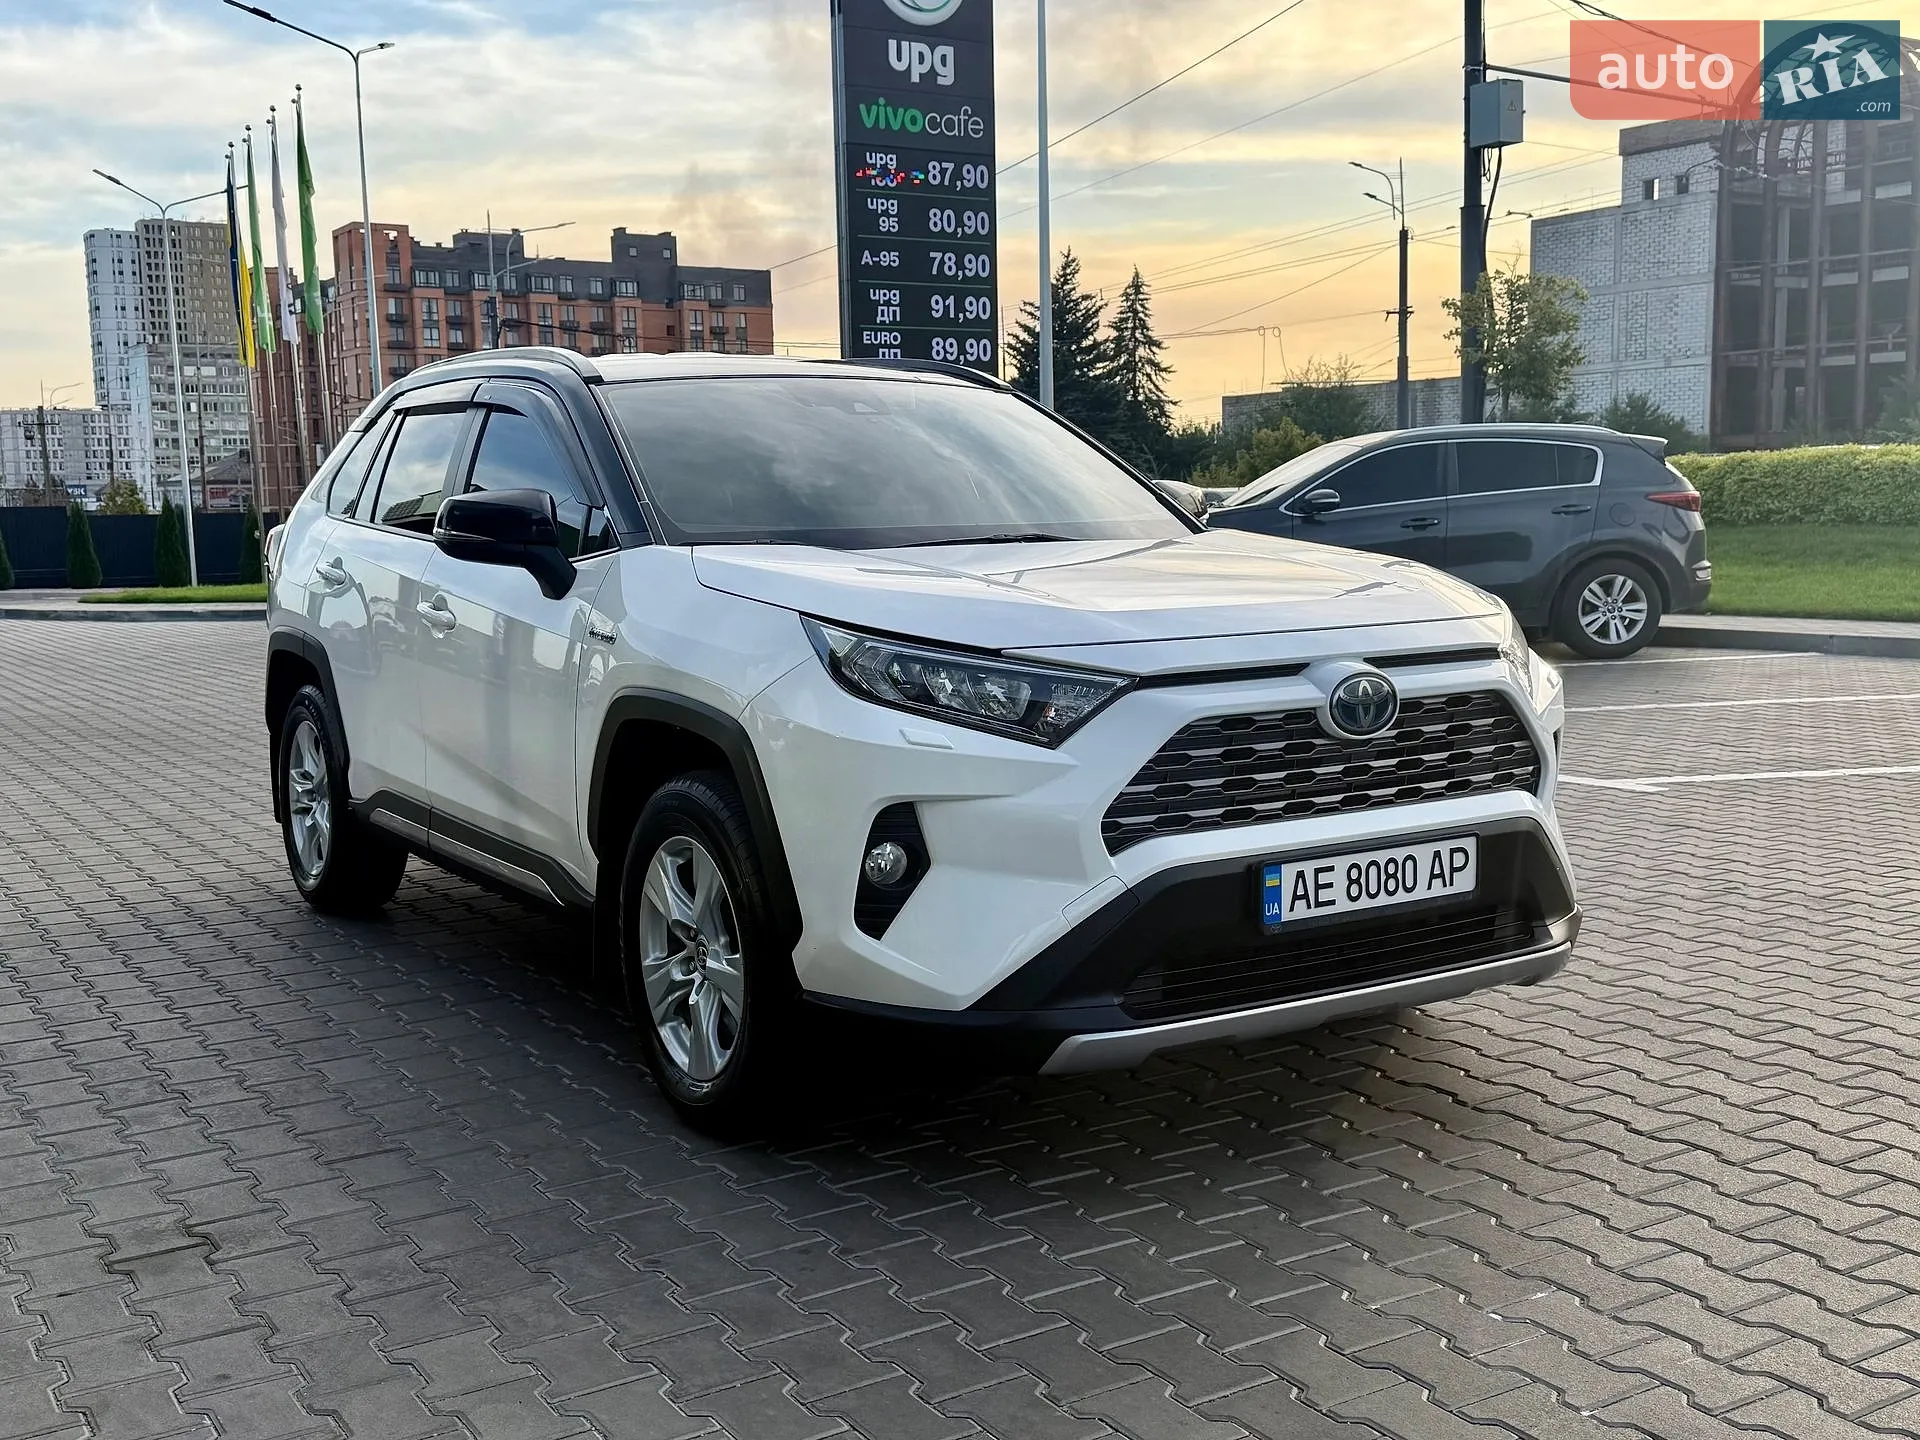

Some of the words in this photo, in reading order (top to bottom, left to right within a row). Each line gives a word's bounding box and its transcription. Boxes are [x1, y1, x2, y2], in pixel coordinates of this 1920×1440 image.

[888, 39, 954, 86] upg
[866, 151, 897, 168] upg
[927, 160, 989, 191] 87,90
[867, 197, 898, 214] upg
[878, 216, 899, 233] 95
[928, 207, 990, 238] 80,90
[929, 251, 990, 281] 78,90
[869, 288, 900, 304] upg
[876, 306, 900, 324] ДП
[930, 294, 991, 323] 91,90
[862, 330, 901, 345] EURO
[931, 337, 992, 365] 89,90
[1288, 864, 1336, 913] AE
[1346, 853, 1418, 902] 8080
[1426, 846, 1470, 891] AP
[1265, 902, 1280, 916] UA
